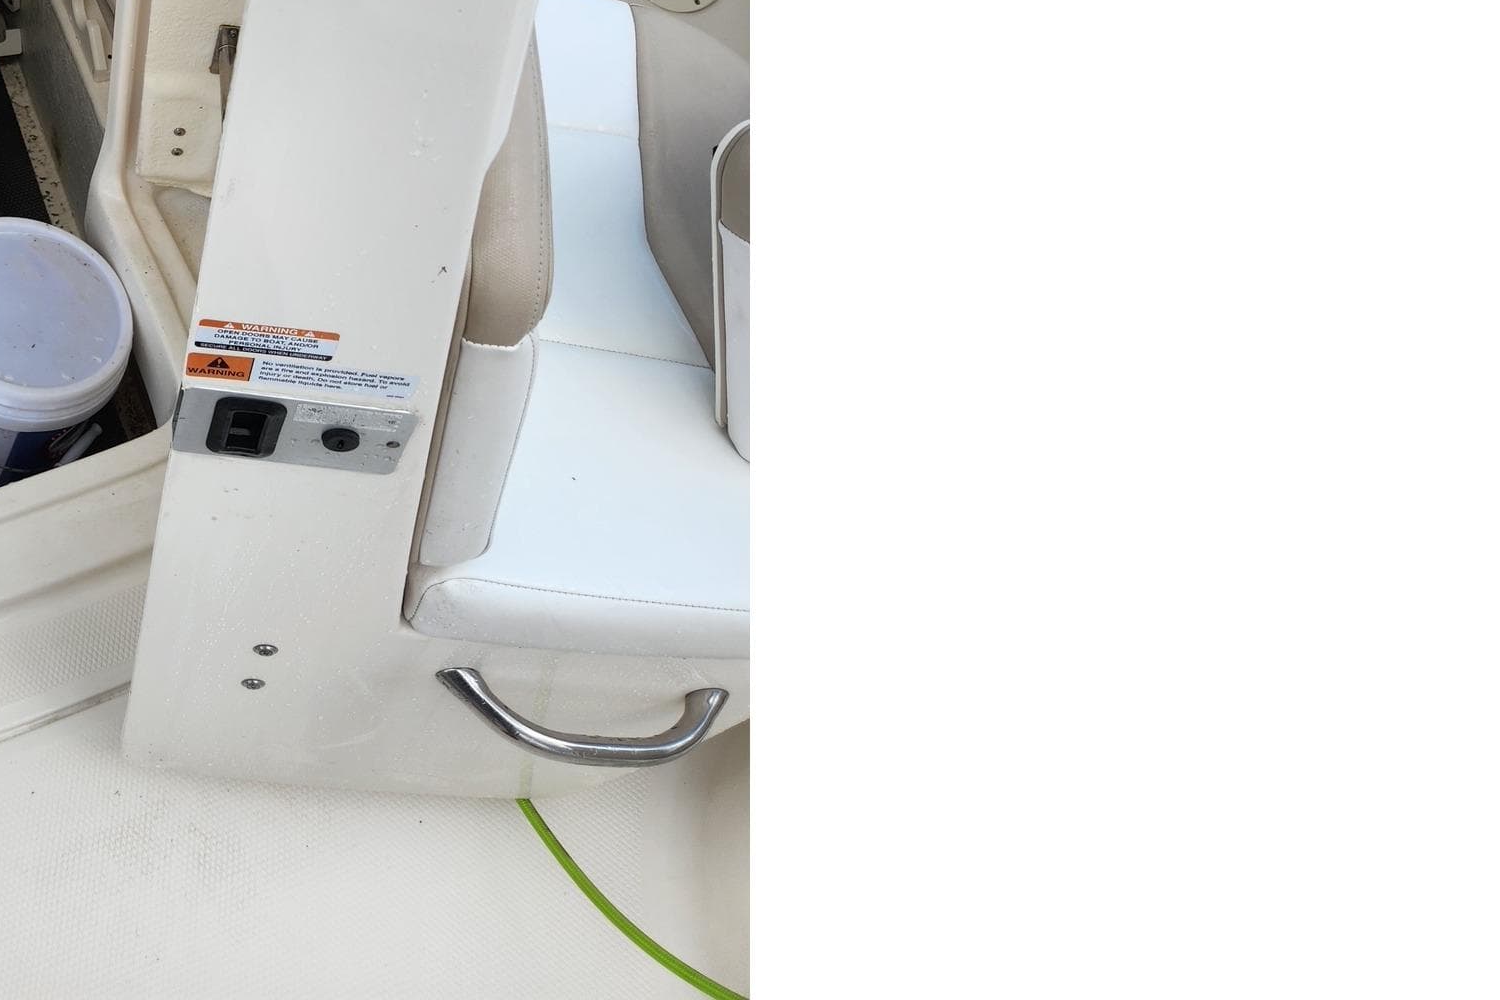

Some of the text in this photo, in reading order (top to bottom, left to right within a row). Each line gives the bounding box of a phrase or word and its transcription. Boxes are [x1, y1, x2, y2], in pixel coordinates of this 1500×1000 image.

[242, 323, 298, 335] WARNING
[214, 333, 249, 341] DAMAGE
[288, 341, 319, 349] AND/OR
[229, 340, 302, 352] PERSONAL INJURY
[188, 367, 245, 378] WARNING
[275, 363, 314, 371] ventilation
[260, 370, 281, 378] injury
[311, 371, 348, 380] explosion
[258, 375, 297, 385] flammable
[298, 380, 323, 388] liquids
